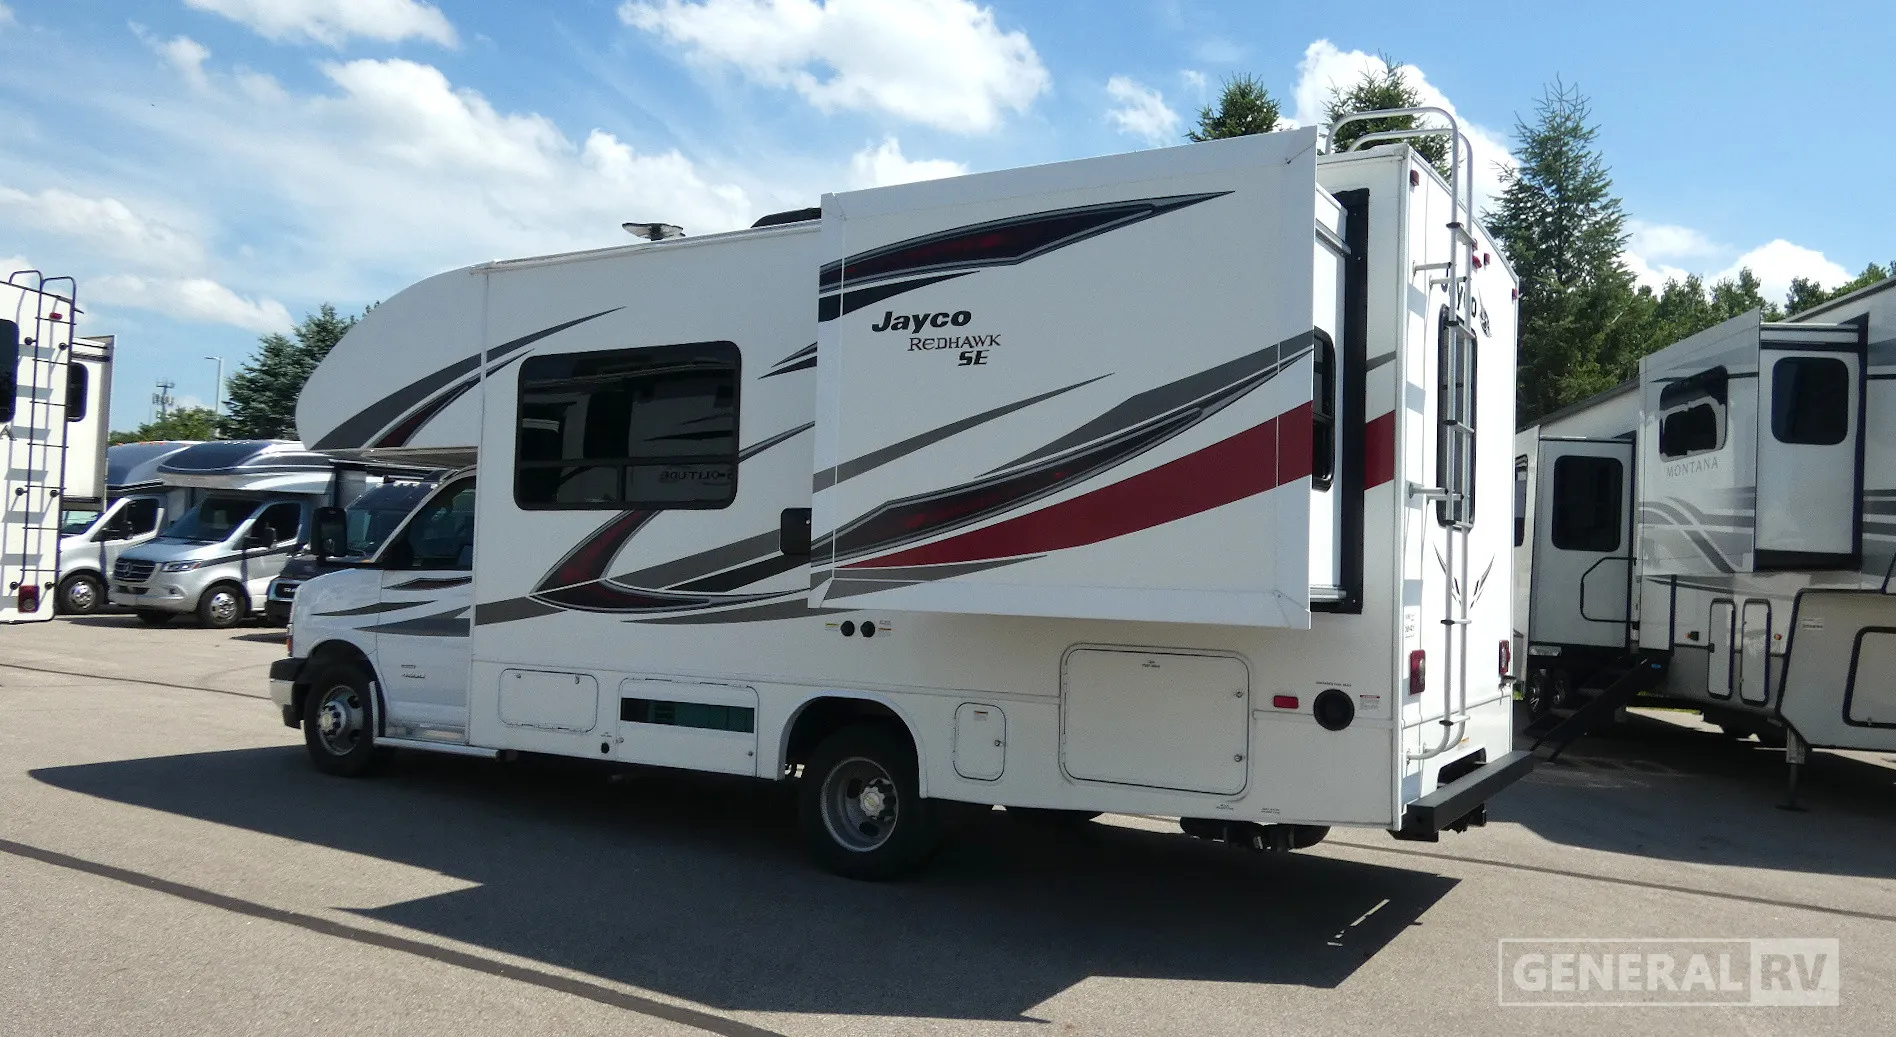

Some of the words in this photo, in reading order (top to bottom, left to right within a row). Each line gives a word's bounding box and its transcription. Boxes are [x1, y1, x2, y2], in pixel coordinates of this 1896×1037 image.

[871, 310, 972, 334] Jayco
[908, 334, 1001, 351] REDHAWK
[958, 350, 990, 366] SE
[1666, 457, 1719, 478] MONTANA
